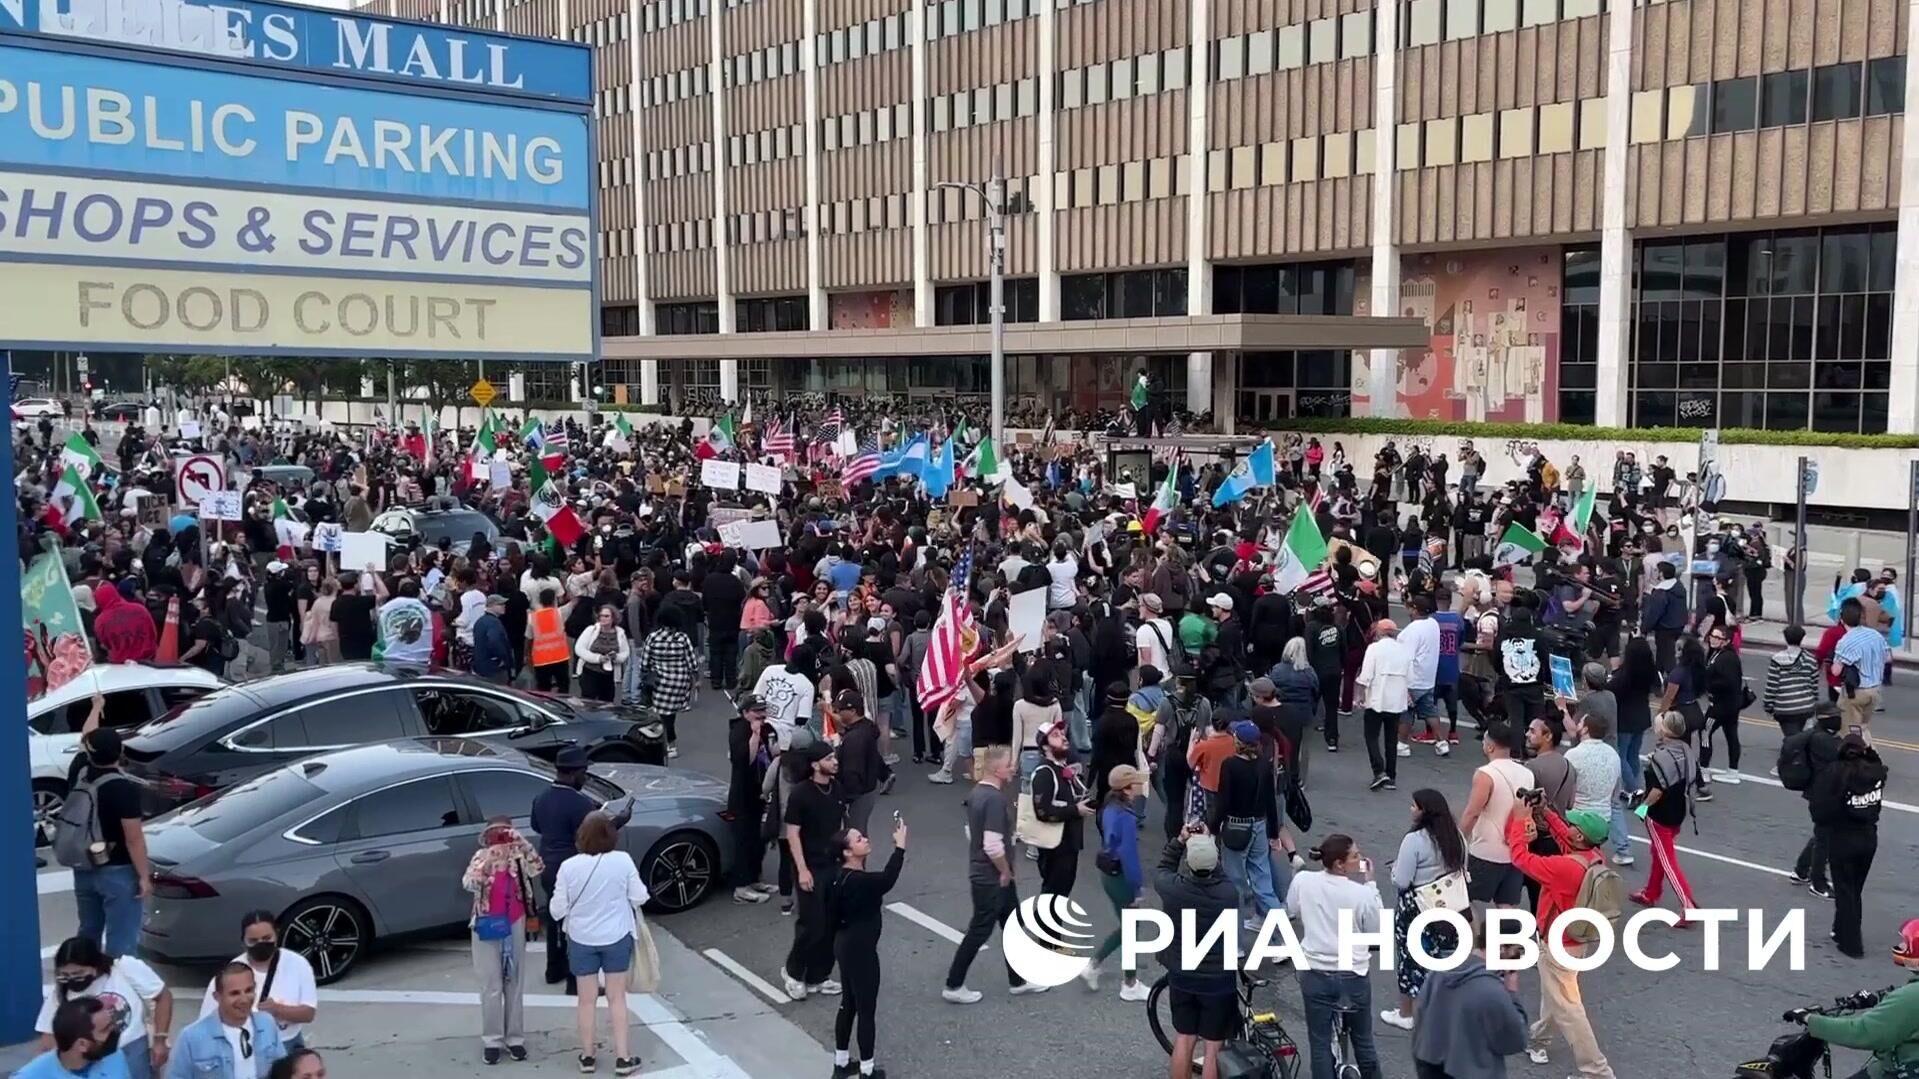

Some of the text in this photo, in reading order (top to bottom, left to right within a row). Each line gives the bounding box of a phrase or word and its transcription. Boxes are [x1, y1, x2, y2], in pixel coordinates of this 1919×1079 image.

[331, 17, 523, 89] MALL
[285, 110, 564, 185] PARKING
[0, 188, 587, 269] HOPS & SERVICES
[78, 281, 497, 340] FOOD COURT
